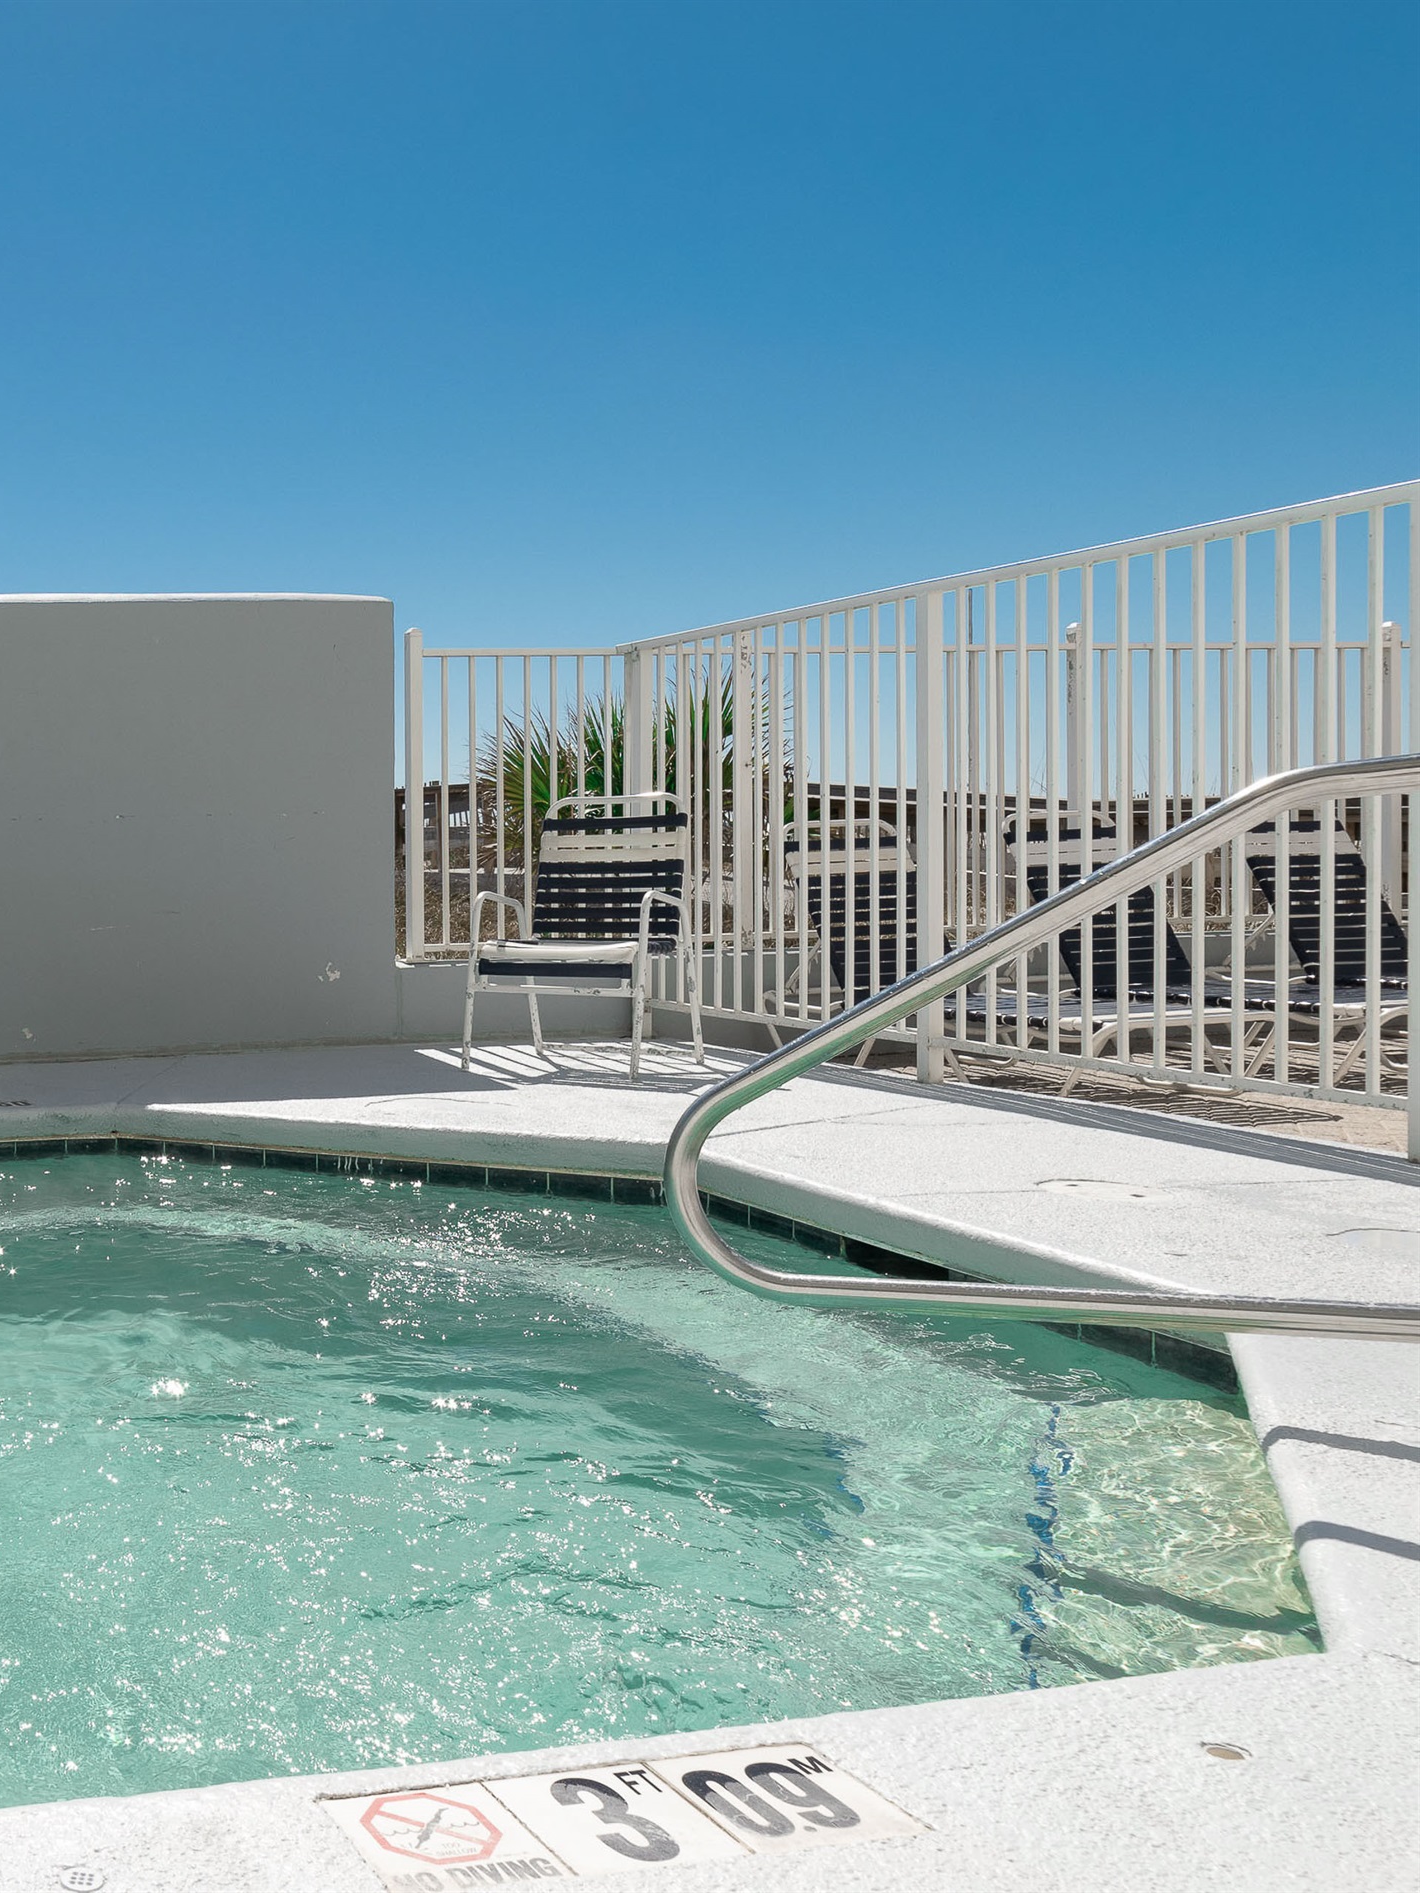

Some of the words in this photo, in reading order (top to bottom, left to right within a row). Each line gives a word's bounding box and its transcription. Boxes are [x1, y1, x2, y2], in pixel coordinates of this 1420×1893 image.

[613, 1769, 663, 1796] FT
[682, 1762, 861, 1838] 0.9
[787, 1756, 834, 1775] M
[550, 1777, 680, 1862] 3
[446, 1857, 564, 1888] DIVING
